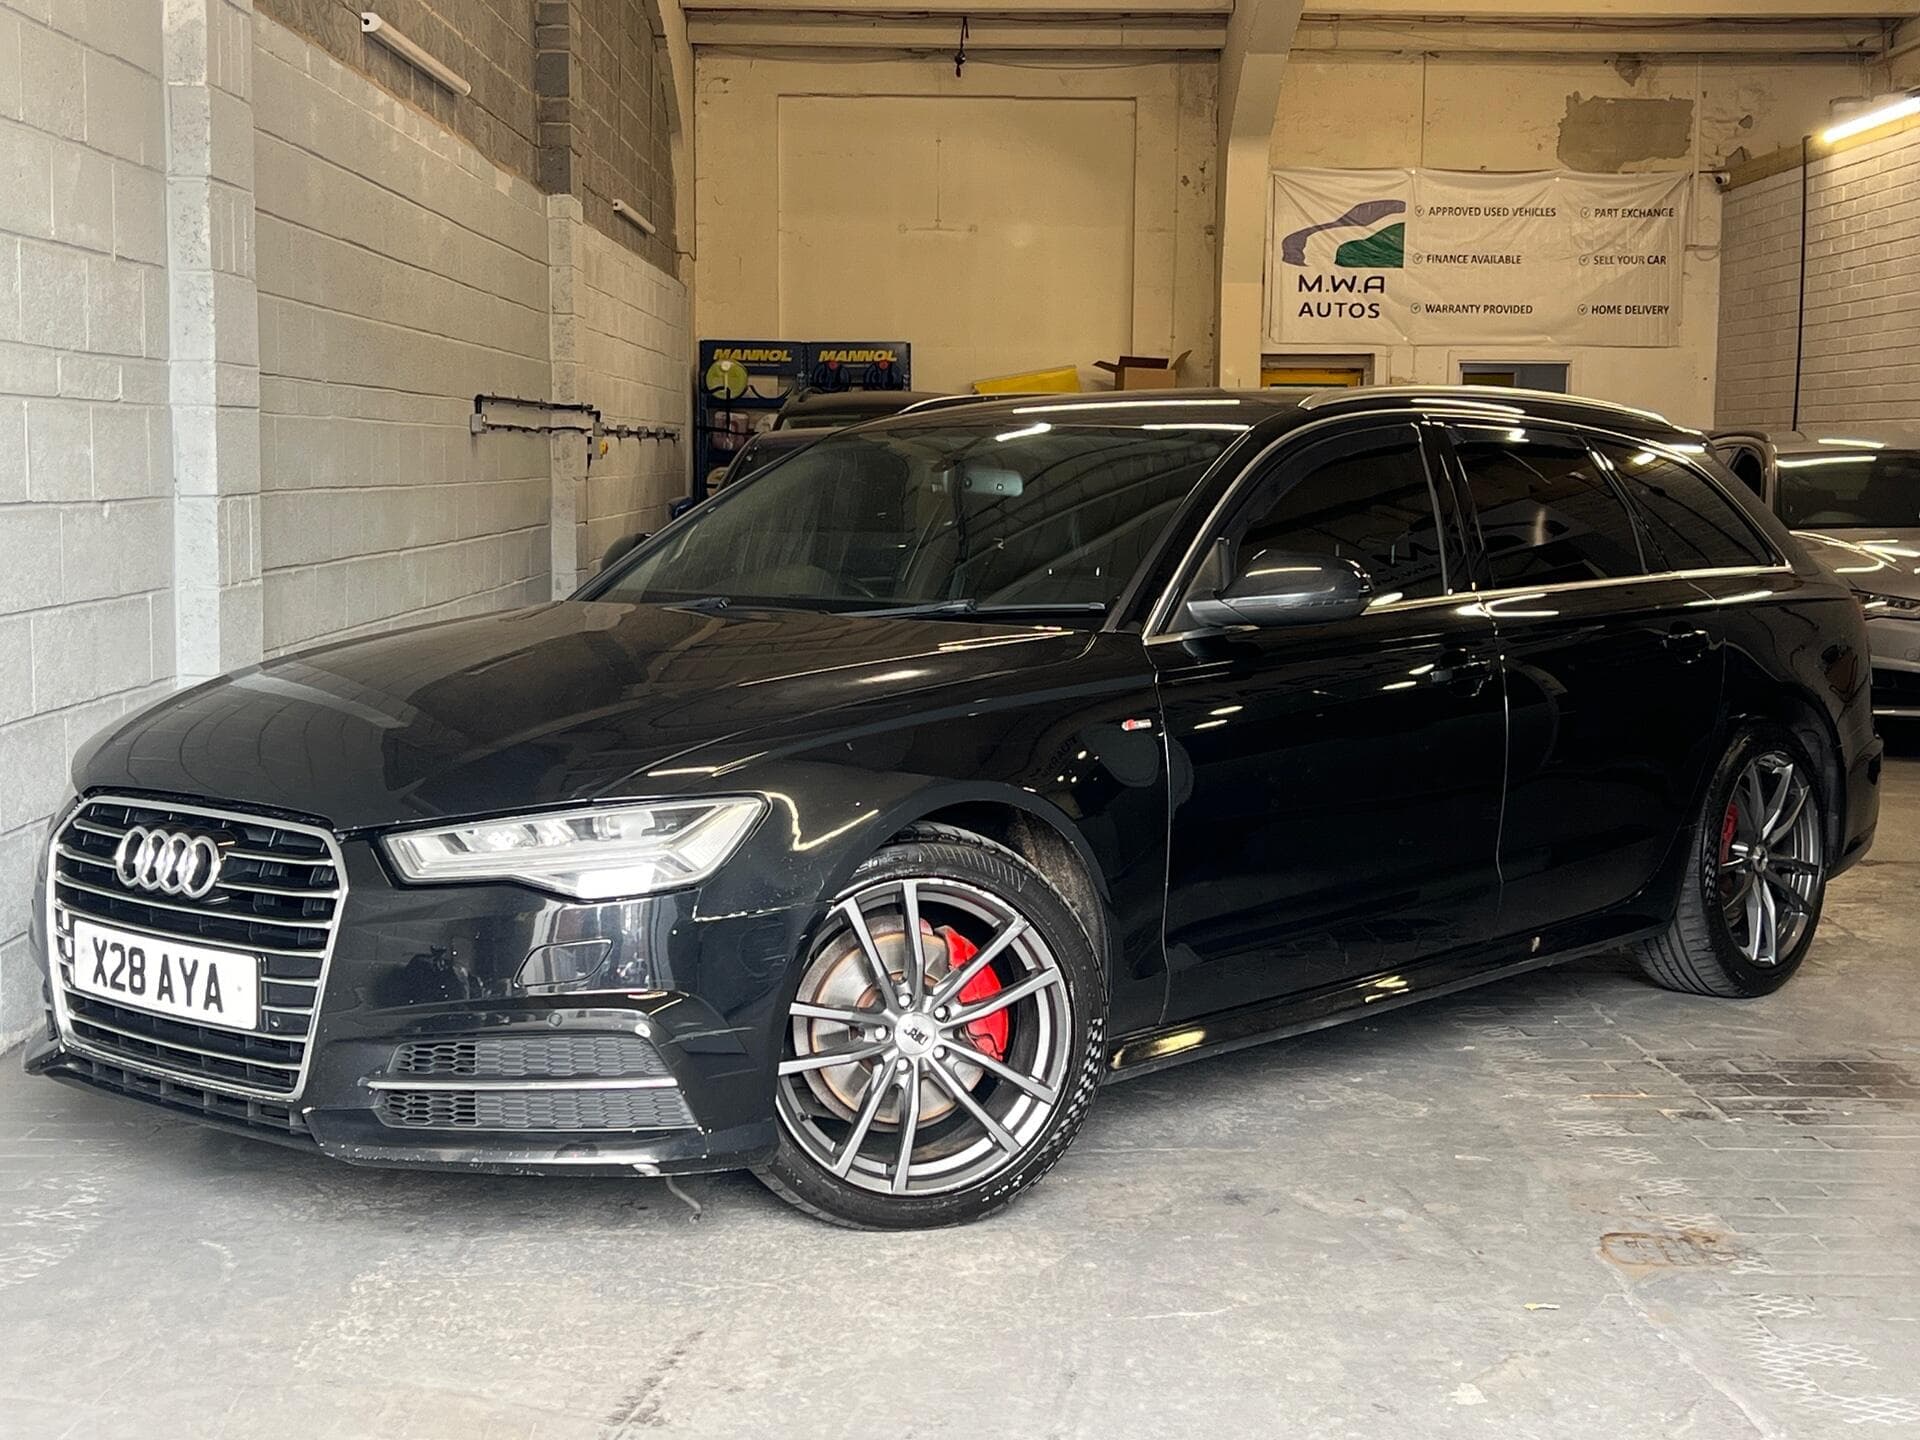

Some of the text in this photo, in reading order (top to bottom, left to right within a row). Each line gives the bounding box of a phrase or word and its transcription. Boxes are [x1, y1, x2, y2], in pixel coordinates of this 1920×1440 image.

[1428, 207, 1557, 217] APPROVED USED VEHICLES
[1594, 207, 1674, 218] PART EXCHANGE
[1426, 254, 1522, 264] FINANCE AVAILABLE
[1593, 255, 1667, 265] SELL YOUR CAR
[1298, 274, 1385, 294] M.W.A
[1298, 302, 1380, 319] AUTOS
[1425, 304, 1533, 314] WARRANTY PROVIDED
[1591, 305, 1670, 315] HOME DELIVERY
[713, 348, 792, 362] MANNOL
[819, 350, 897, 362] MANNOL
[92, 936, 224, 1013] X28 AYA
